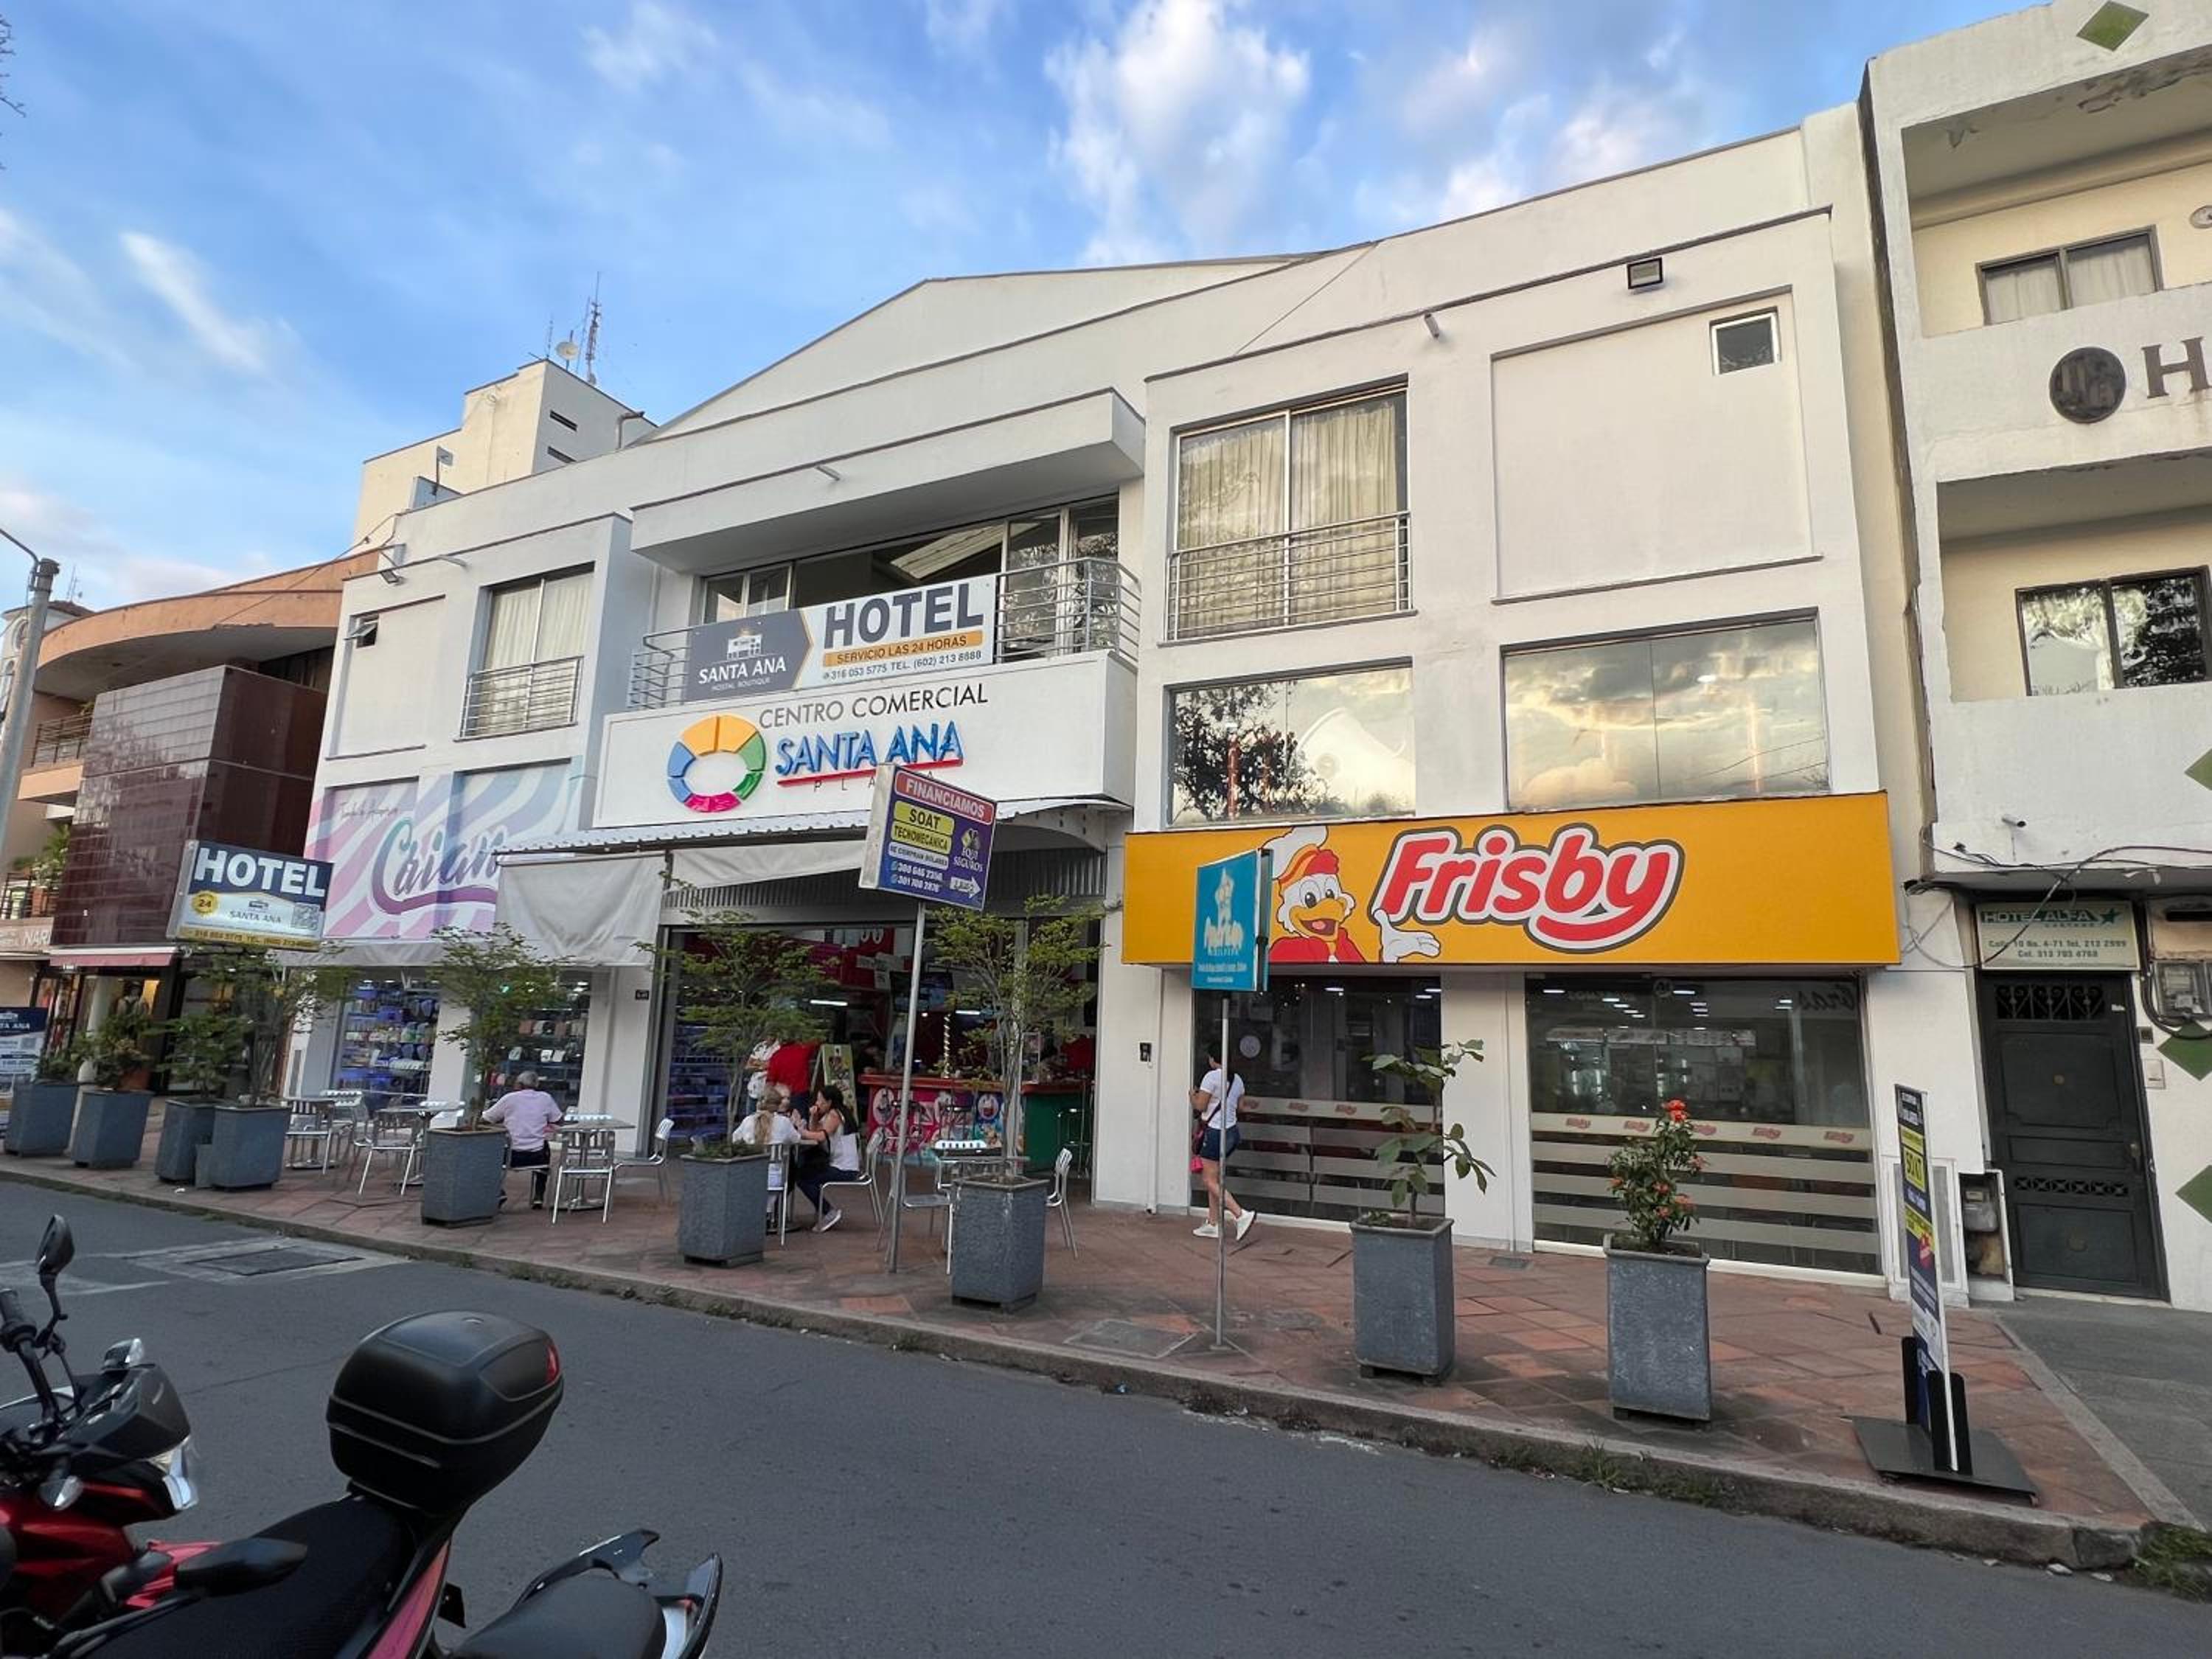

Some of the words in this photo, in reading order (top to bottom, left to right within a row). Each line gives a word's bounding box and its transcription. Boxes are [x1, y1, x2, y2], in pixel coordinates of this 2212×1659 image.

[824, 583, 984, 649] HOTEL
[837, 649, 886, 664] SERVICIO
[888, 644, 909, 655] LAS
[912, 640, 924, 652] 24
[927, 635, 967, 651] HORAS
[891, 661, 911, 672] TEL.
[914, 658, 937, 671] (602)
[939, 654, 956, 664] 213
[699, 662, 748, 684] SANTA
[752, 656, 787, 675] ANA
[759, 701, 844, 729] CENTRO
[852, 683, 988, 718] COMERCIAL
[775, 729, 878, 776] SANTA
[885, 720, 964, 764] ANA
[905, 778, 986, 818] FINANCIAMOS
[909, 808, 941, 830] SOAT
[194, 847, 325, 897] HOTEL
[1380, 832, 1672, 944] Frisby
[199, 899, 212, 908] 24
[229, 910, 260, 921] SANTA
[262, 914, 282, 924] ANA
[1982, 911, 2040, 923] HOTEL
[2044, 910, 2096, 922] ALFA
